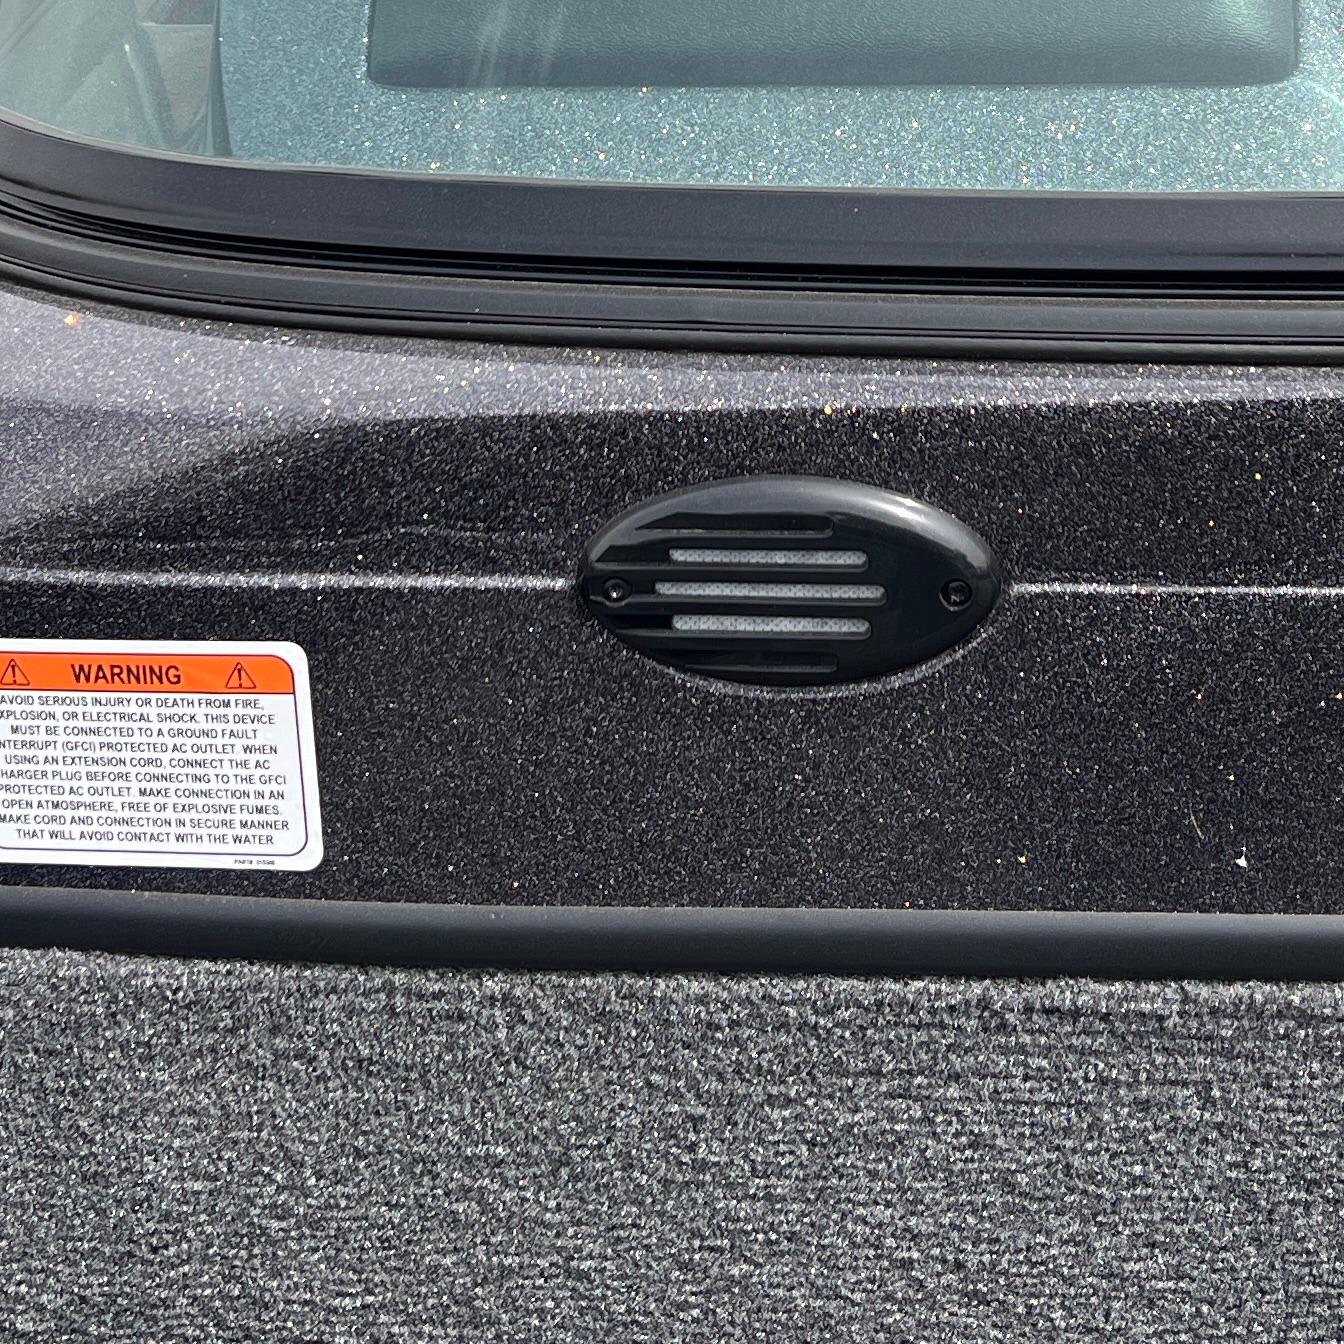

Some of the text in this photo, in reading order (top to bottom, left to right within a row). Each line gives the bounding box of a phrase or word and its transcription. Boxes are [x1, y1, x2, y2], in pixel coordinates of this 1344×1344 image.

[71, 663, 182, 685] WARNING
[0, 695, 264, 710] AVOID SERIOUS INJURY OR DEATH FROM FIRE,
[62, 711, 79, 721] OR
[82, 711, 153, 723] ELECTRICAL
[204, 713, 230, 724] THIS
[233, 714, 275, 725] DEVICE
[10, 725, 258, 739] MUST BE CONNECTED TO A GROUND FAULT
[62, 740, 96, 753] (GFCI)
[99, 741, 168, 753] PROTECTED
[172, 743, 187, 753] AC
[242, 744, 277, 755] WHEN
[5, 754, 270, 770] USING AN EXTENSION CORD, CONNECT THE AC
[51, 770, 82, 781] PLUG
[86, 771, 132, 782] BEFORE
[135, 772, 211, 784] CONNECTING
[214, 774, 230, 784] TO
[234, 774, 256, 784] THE
[259, 774, 287, 785] GFCI
[68, 786, 84, 796] AC
[139, 787, 171, 797] MAKE
[174, 788, 250, 799] CONNECTION
[254, 790, 265, 800] IN
[269, 790, 284, 800] AN
[2, 799, 33, 809] OPEN
[37, 800, 118, 813] ATMOSPHERE,
[121, 802, 151, 812] FREE
[154, 802, 169, 813] OF
[173, 803, 237, 814] EXPLOSIVE
[34, 814, 67, 825] CORD
[70, 815, 93, 826] AND
[97, 816, 171, 828] CONNECTION
[175, 818, 186, 828] IN
[189, 818, 236, 829] SECURE
[240, 820, 289, 830] MANNER
[16, 828, 274, 845] THAT WILL AVOID CONTACT WITH THE WATER
